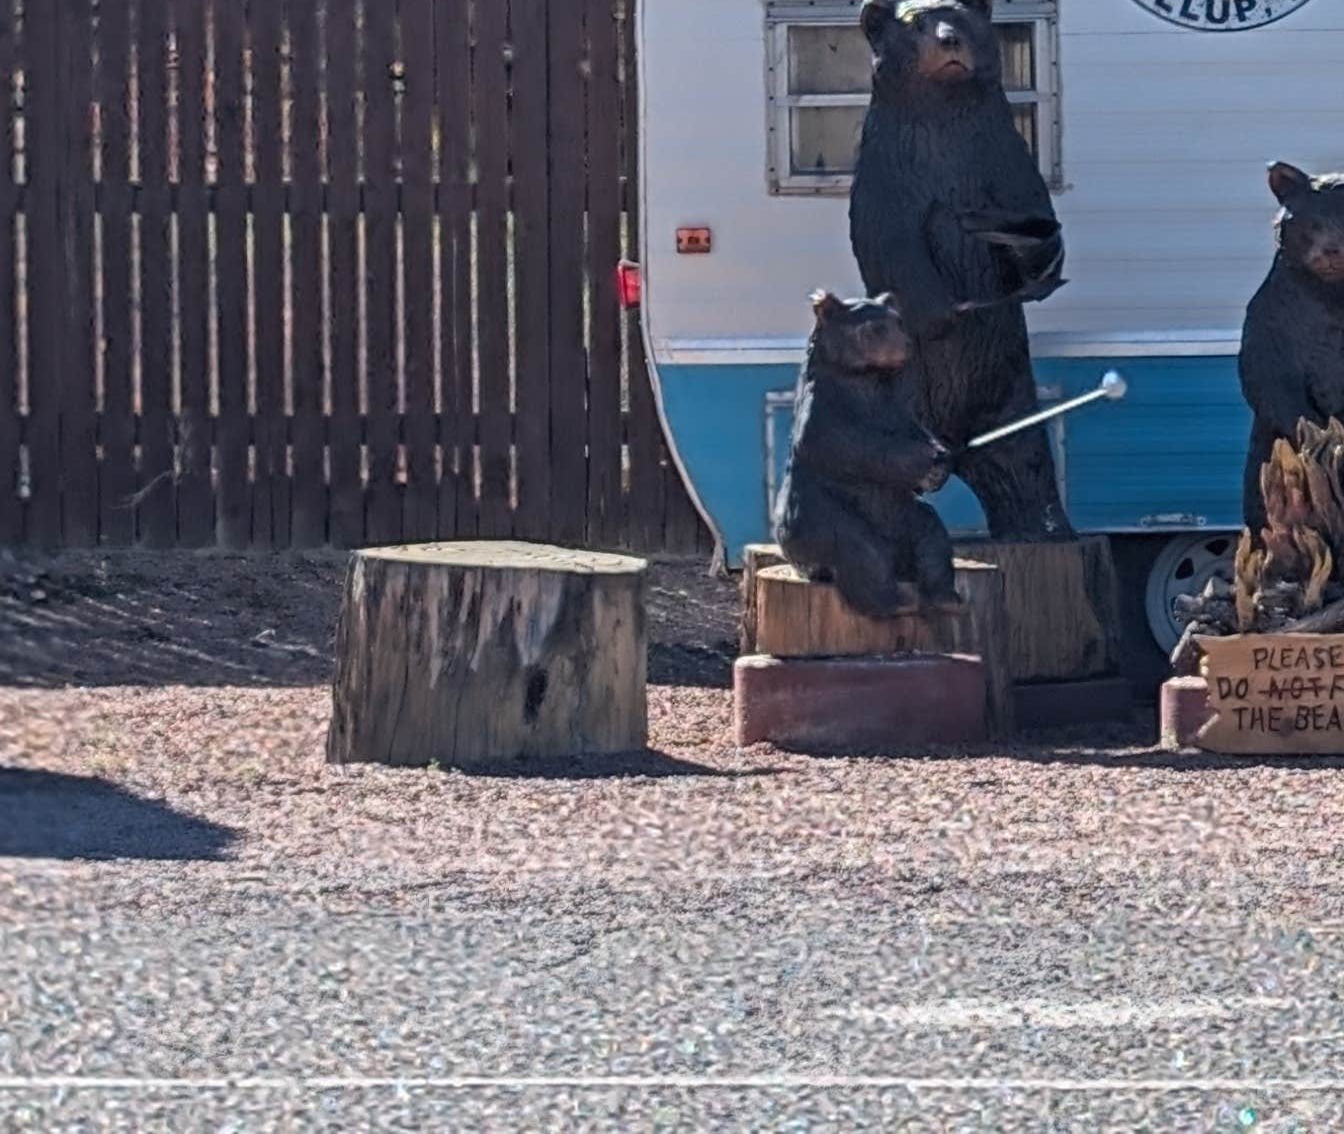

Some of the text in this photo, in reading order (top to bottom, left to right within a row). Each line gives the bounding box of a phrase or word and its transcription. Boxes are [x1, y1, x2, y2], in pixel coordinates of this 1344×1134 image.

[1252, 644, 1344, 671] PLEASE
[1216, 676, 1249, 700] DO
[1264, 676, 1325, 699] NOT
[1232, 707, 1285, 733] THE
